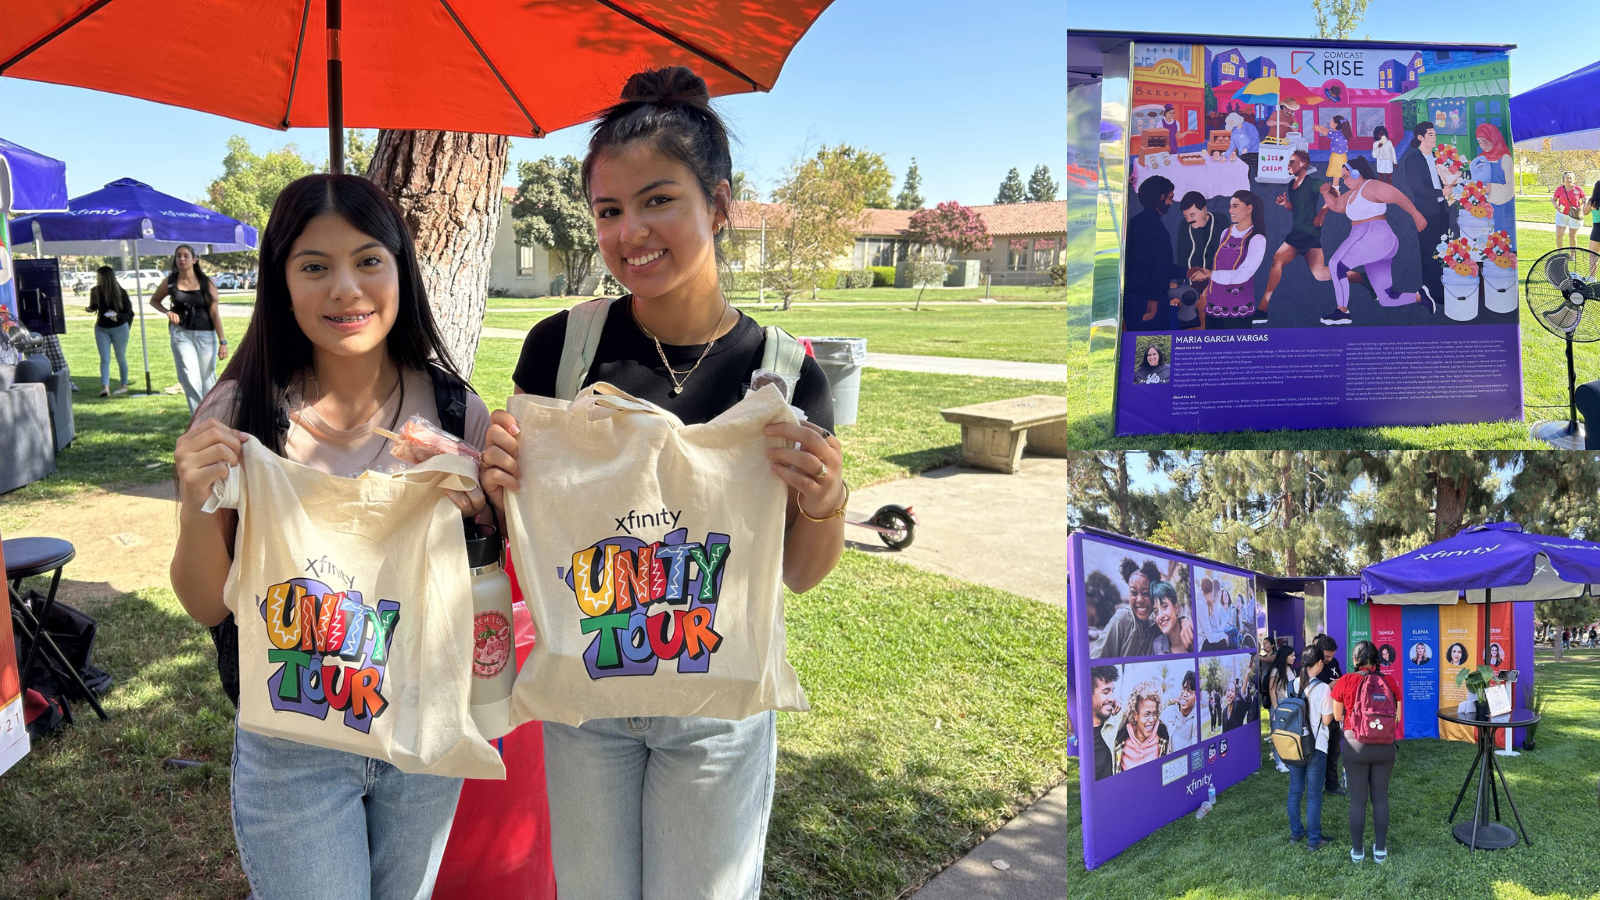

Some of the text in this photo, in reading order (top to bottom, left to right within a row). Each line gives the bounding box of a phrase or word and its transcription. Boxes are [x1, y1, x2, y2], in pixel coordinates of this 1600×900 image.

[1323, 51, 1364, 59] COMCAST
[1158, 65, 1179, 76] GYM
[1324, 60, 1364, 76] RISE
[1135, 86, 1188, 99] Bakery
[1175, 334, 1269, 344] MARIA GARCIA VARGAS
[614, 508, 682, 534] xfinity
[1414, 543, 1501, 561] xfinity
[304, 555, 356, 589] xfinity
[572, 541, 731, 617] UNITY
[266, 582, 400, 665] UNITY
[580, 608, 723, 668] TOUR
[268, 648, 389, 720] TOUR
[1186, 773, 1212, 795] xfinity
